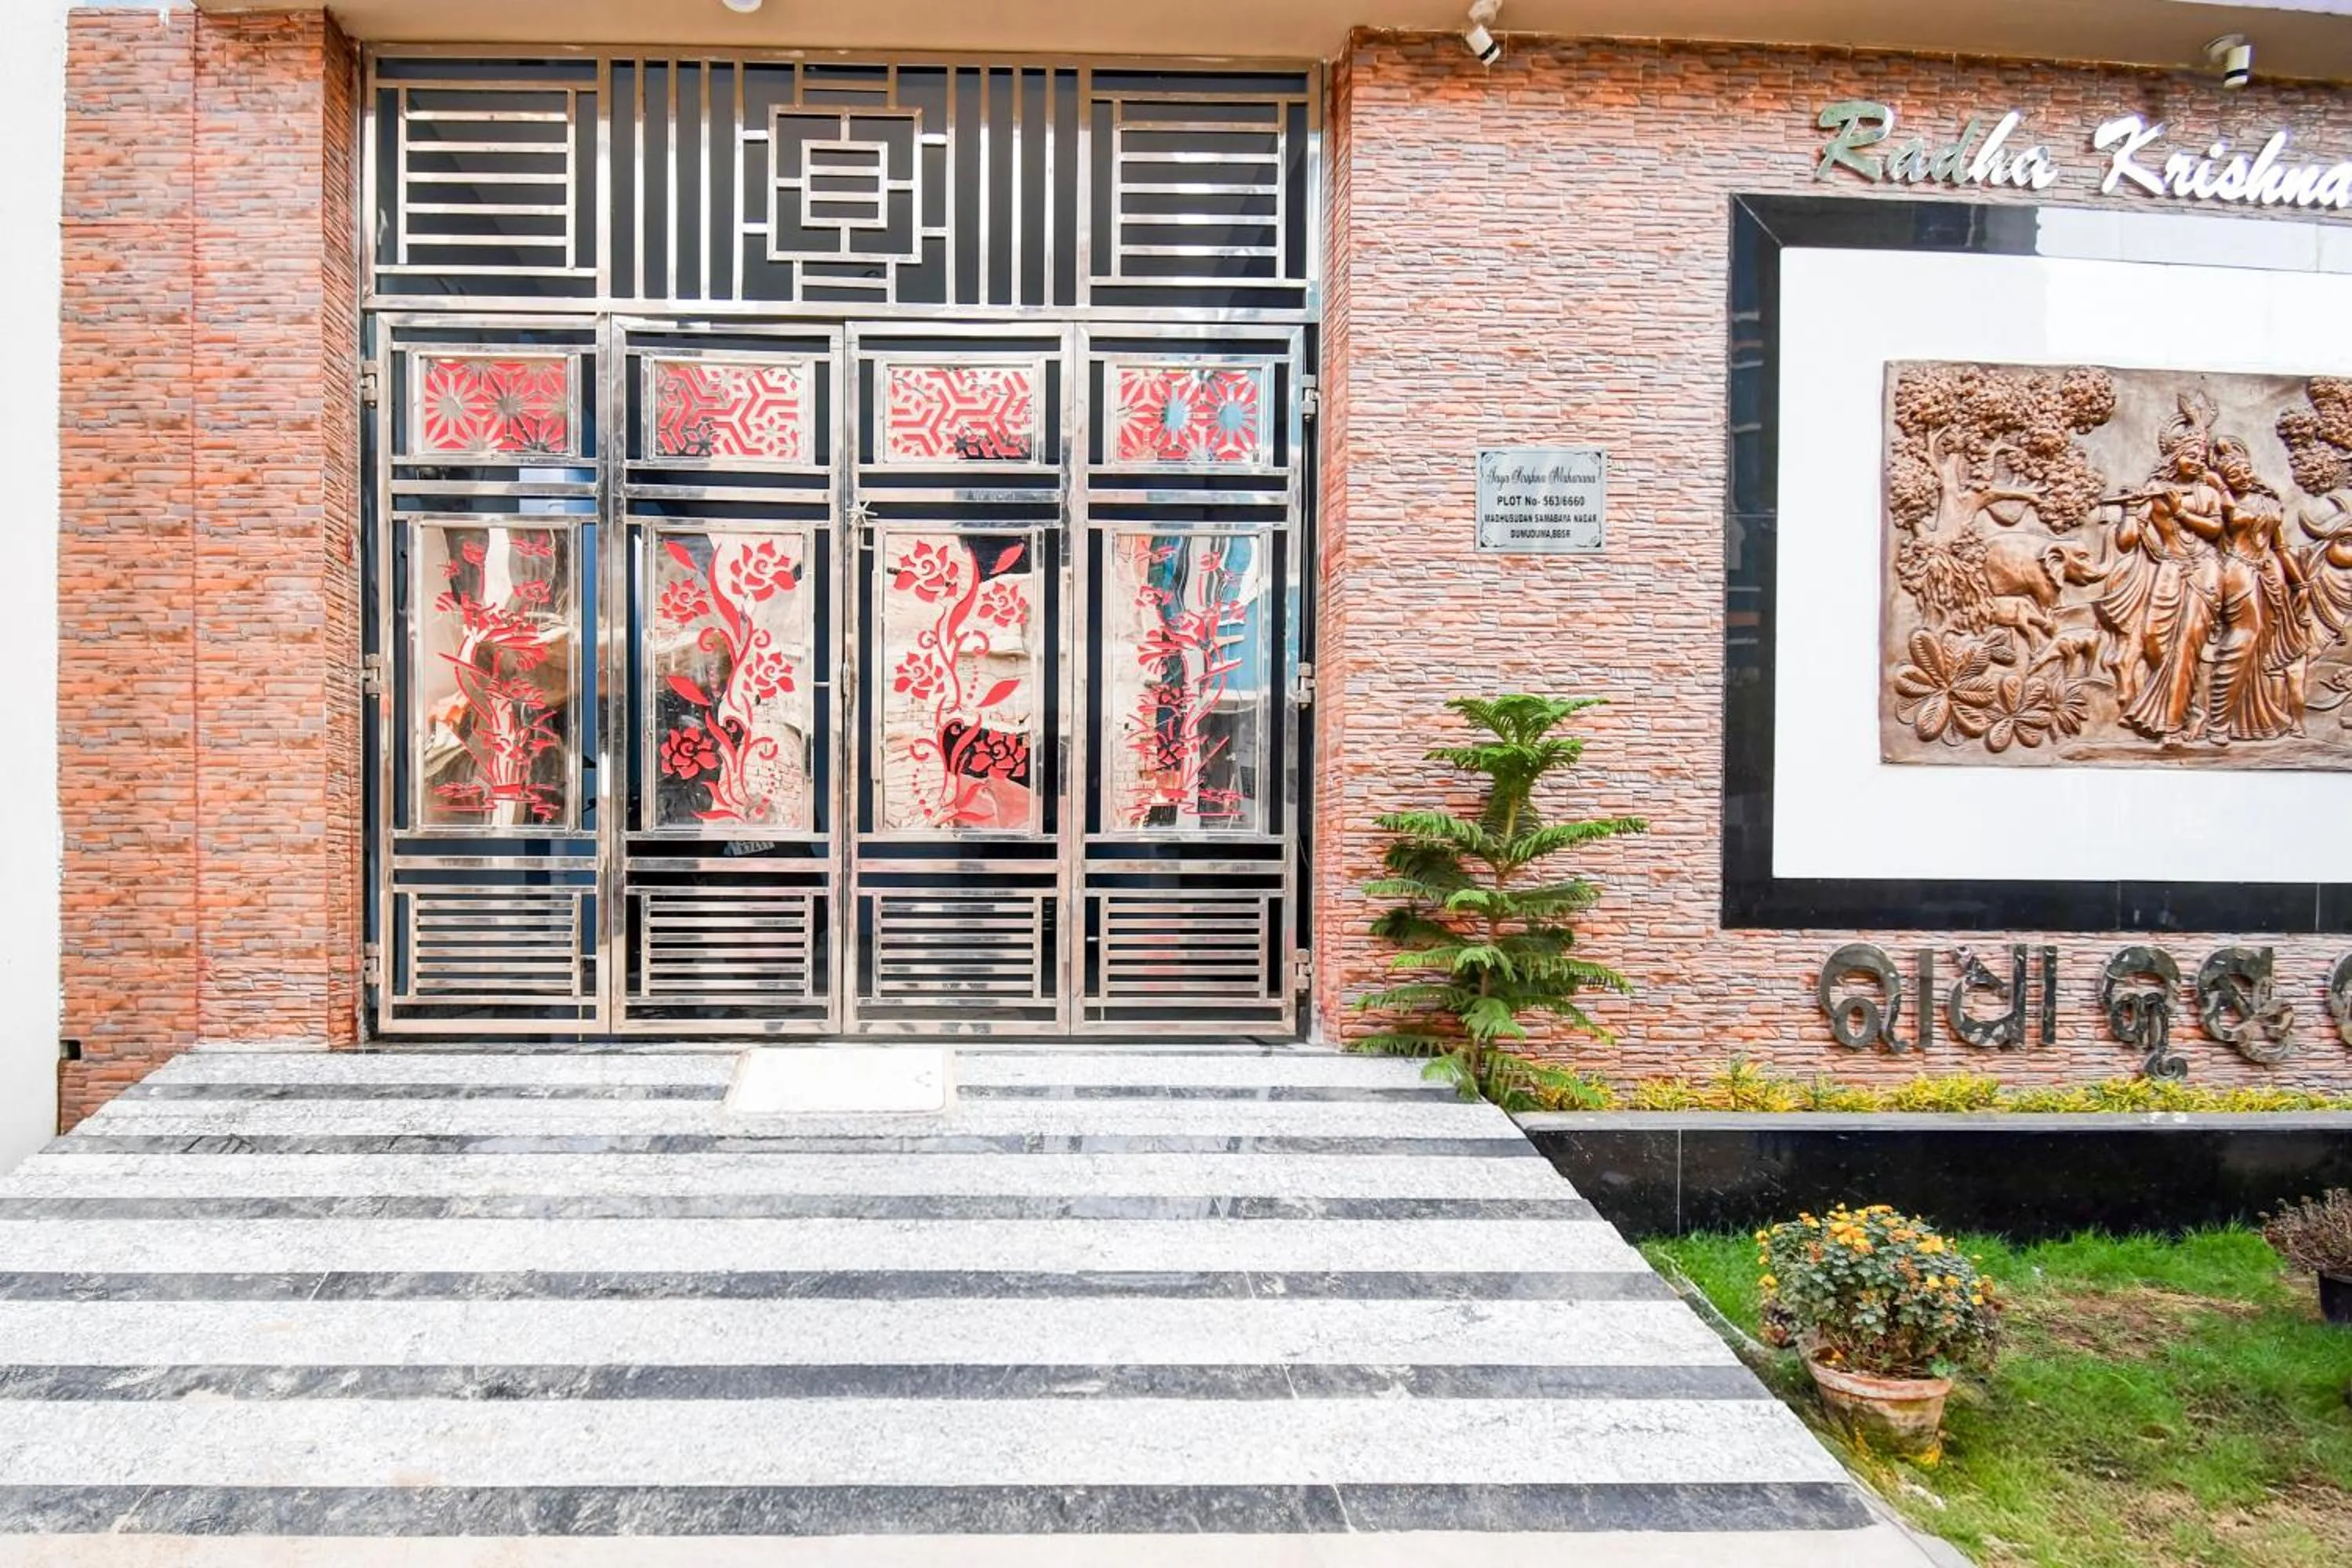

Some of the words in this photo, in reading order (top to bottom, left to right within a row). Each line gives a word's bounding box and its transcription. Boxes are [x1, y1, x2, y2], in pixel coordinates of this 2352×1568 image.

[1814, 100, 2059, 189] Radha
[2094, 113, 2352, 209] Krishna
[1484, 514, 1533, 523] MADHUSUDAN
[1573, 514, 1597, 523] NAGAR
[1497, 495, 1523, 506] PLOT
[1819, 942, 2057, 1054] ରାଧା
